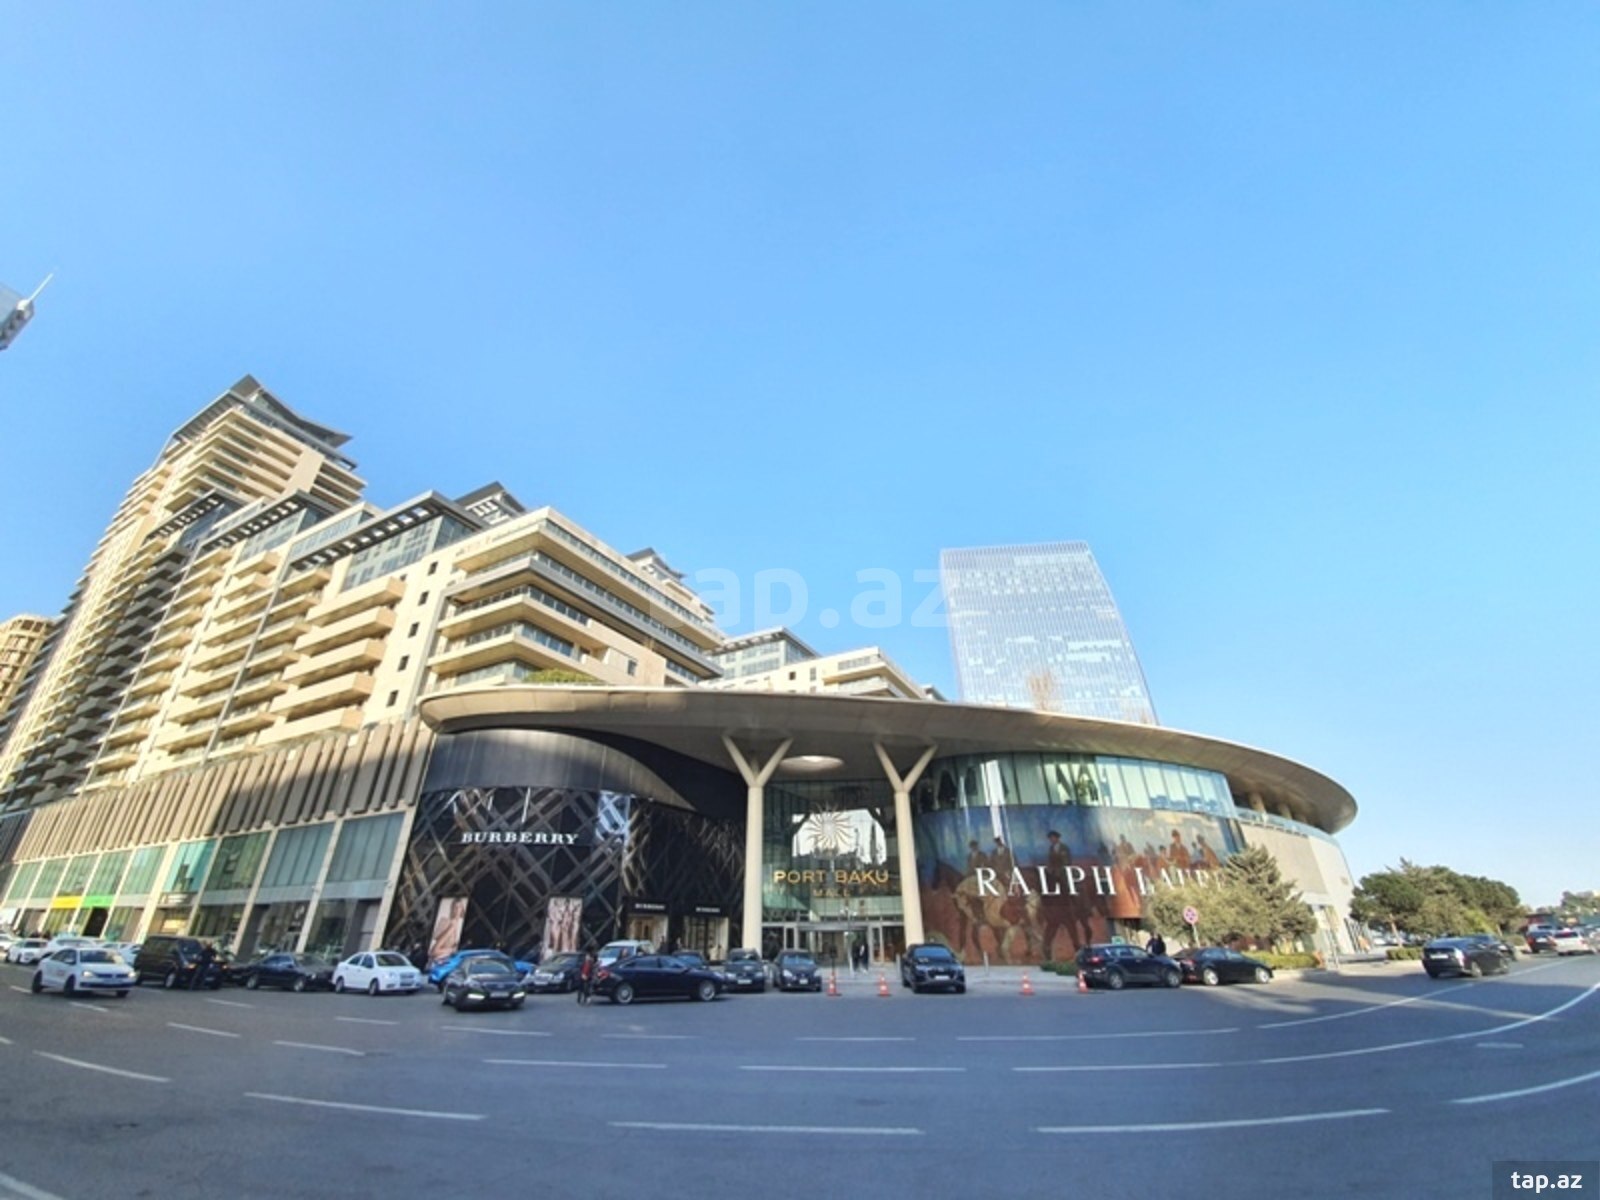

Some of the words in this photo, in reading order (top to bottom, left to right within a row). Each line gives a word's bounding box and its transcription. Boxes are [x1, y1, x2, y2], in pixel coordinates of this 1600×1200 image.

[461, 831, 579, 845] BURBERRY
[773, 869, 826, 884] PORT
[835, 868, 889, 885] BAKU
[975, 865, 1117, 897] RALPH
